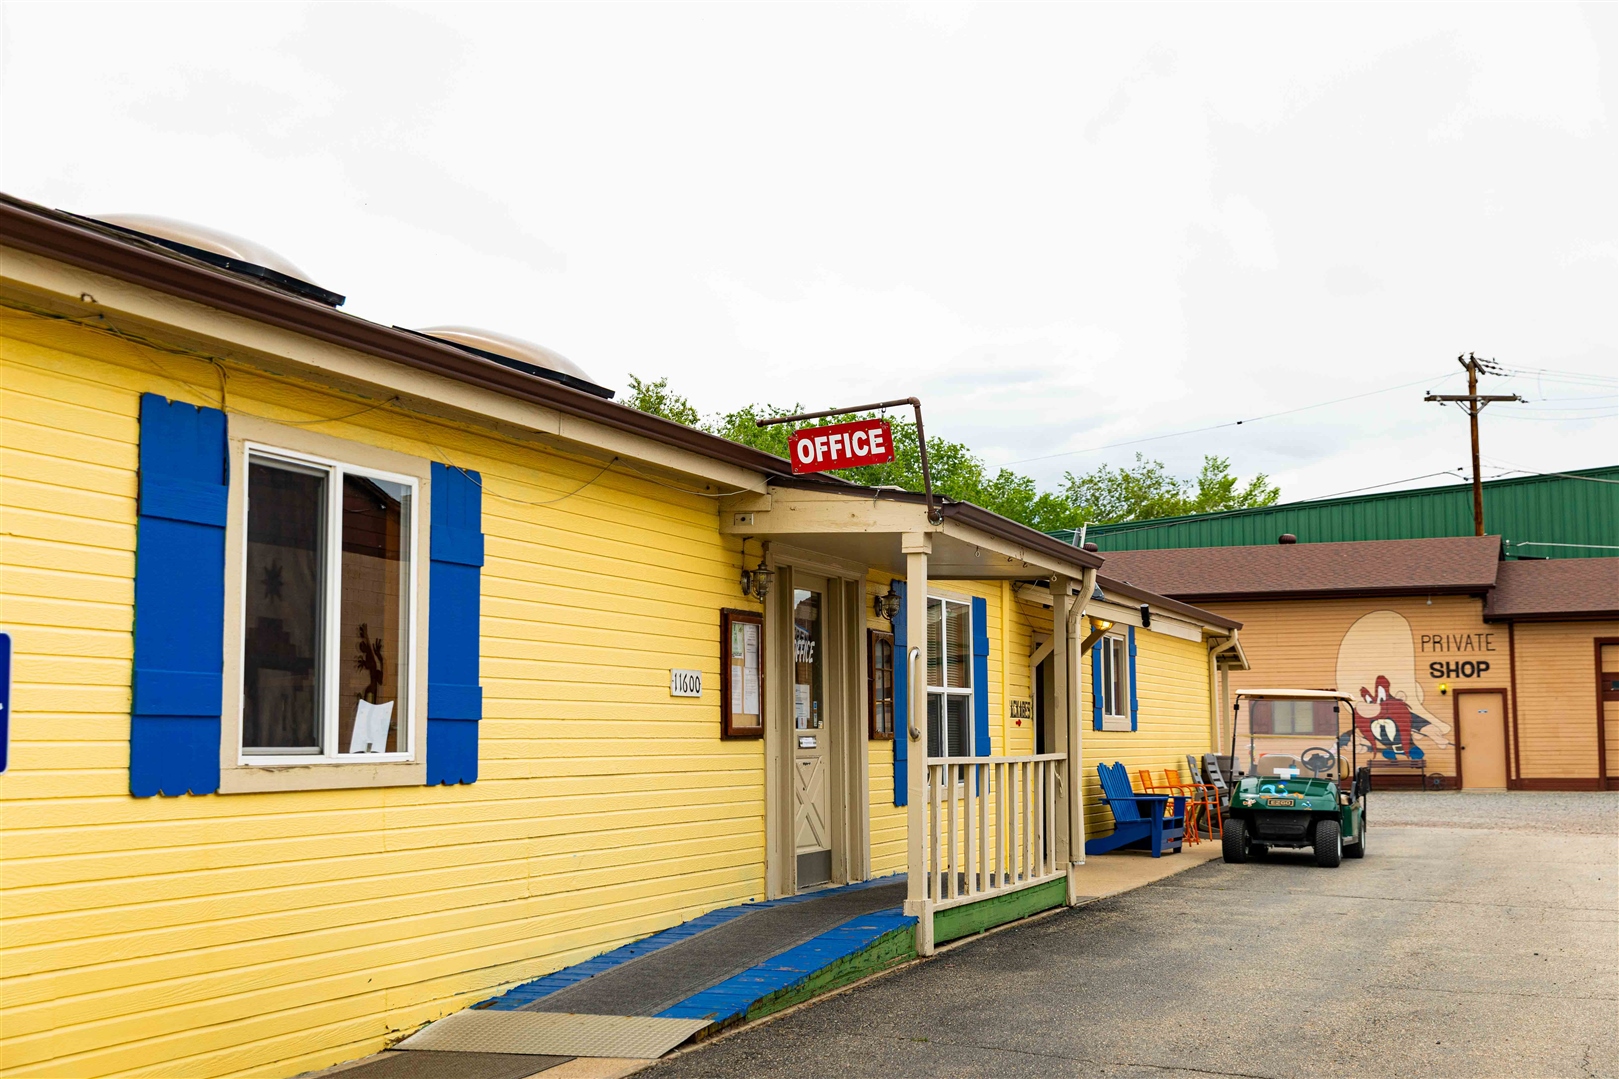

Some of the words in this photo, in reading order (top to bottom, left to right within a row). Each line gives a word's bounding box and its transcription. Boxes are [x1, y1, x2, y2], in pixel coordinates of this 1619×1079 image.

[797, 428, 886, 464] OFFICE
[1421, 633, 1496, 652] PRIVATE
[1429, 661, 1490, 678] SHOP
[674, 672, 701, 694] 11600
